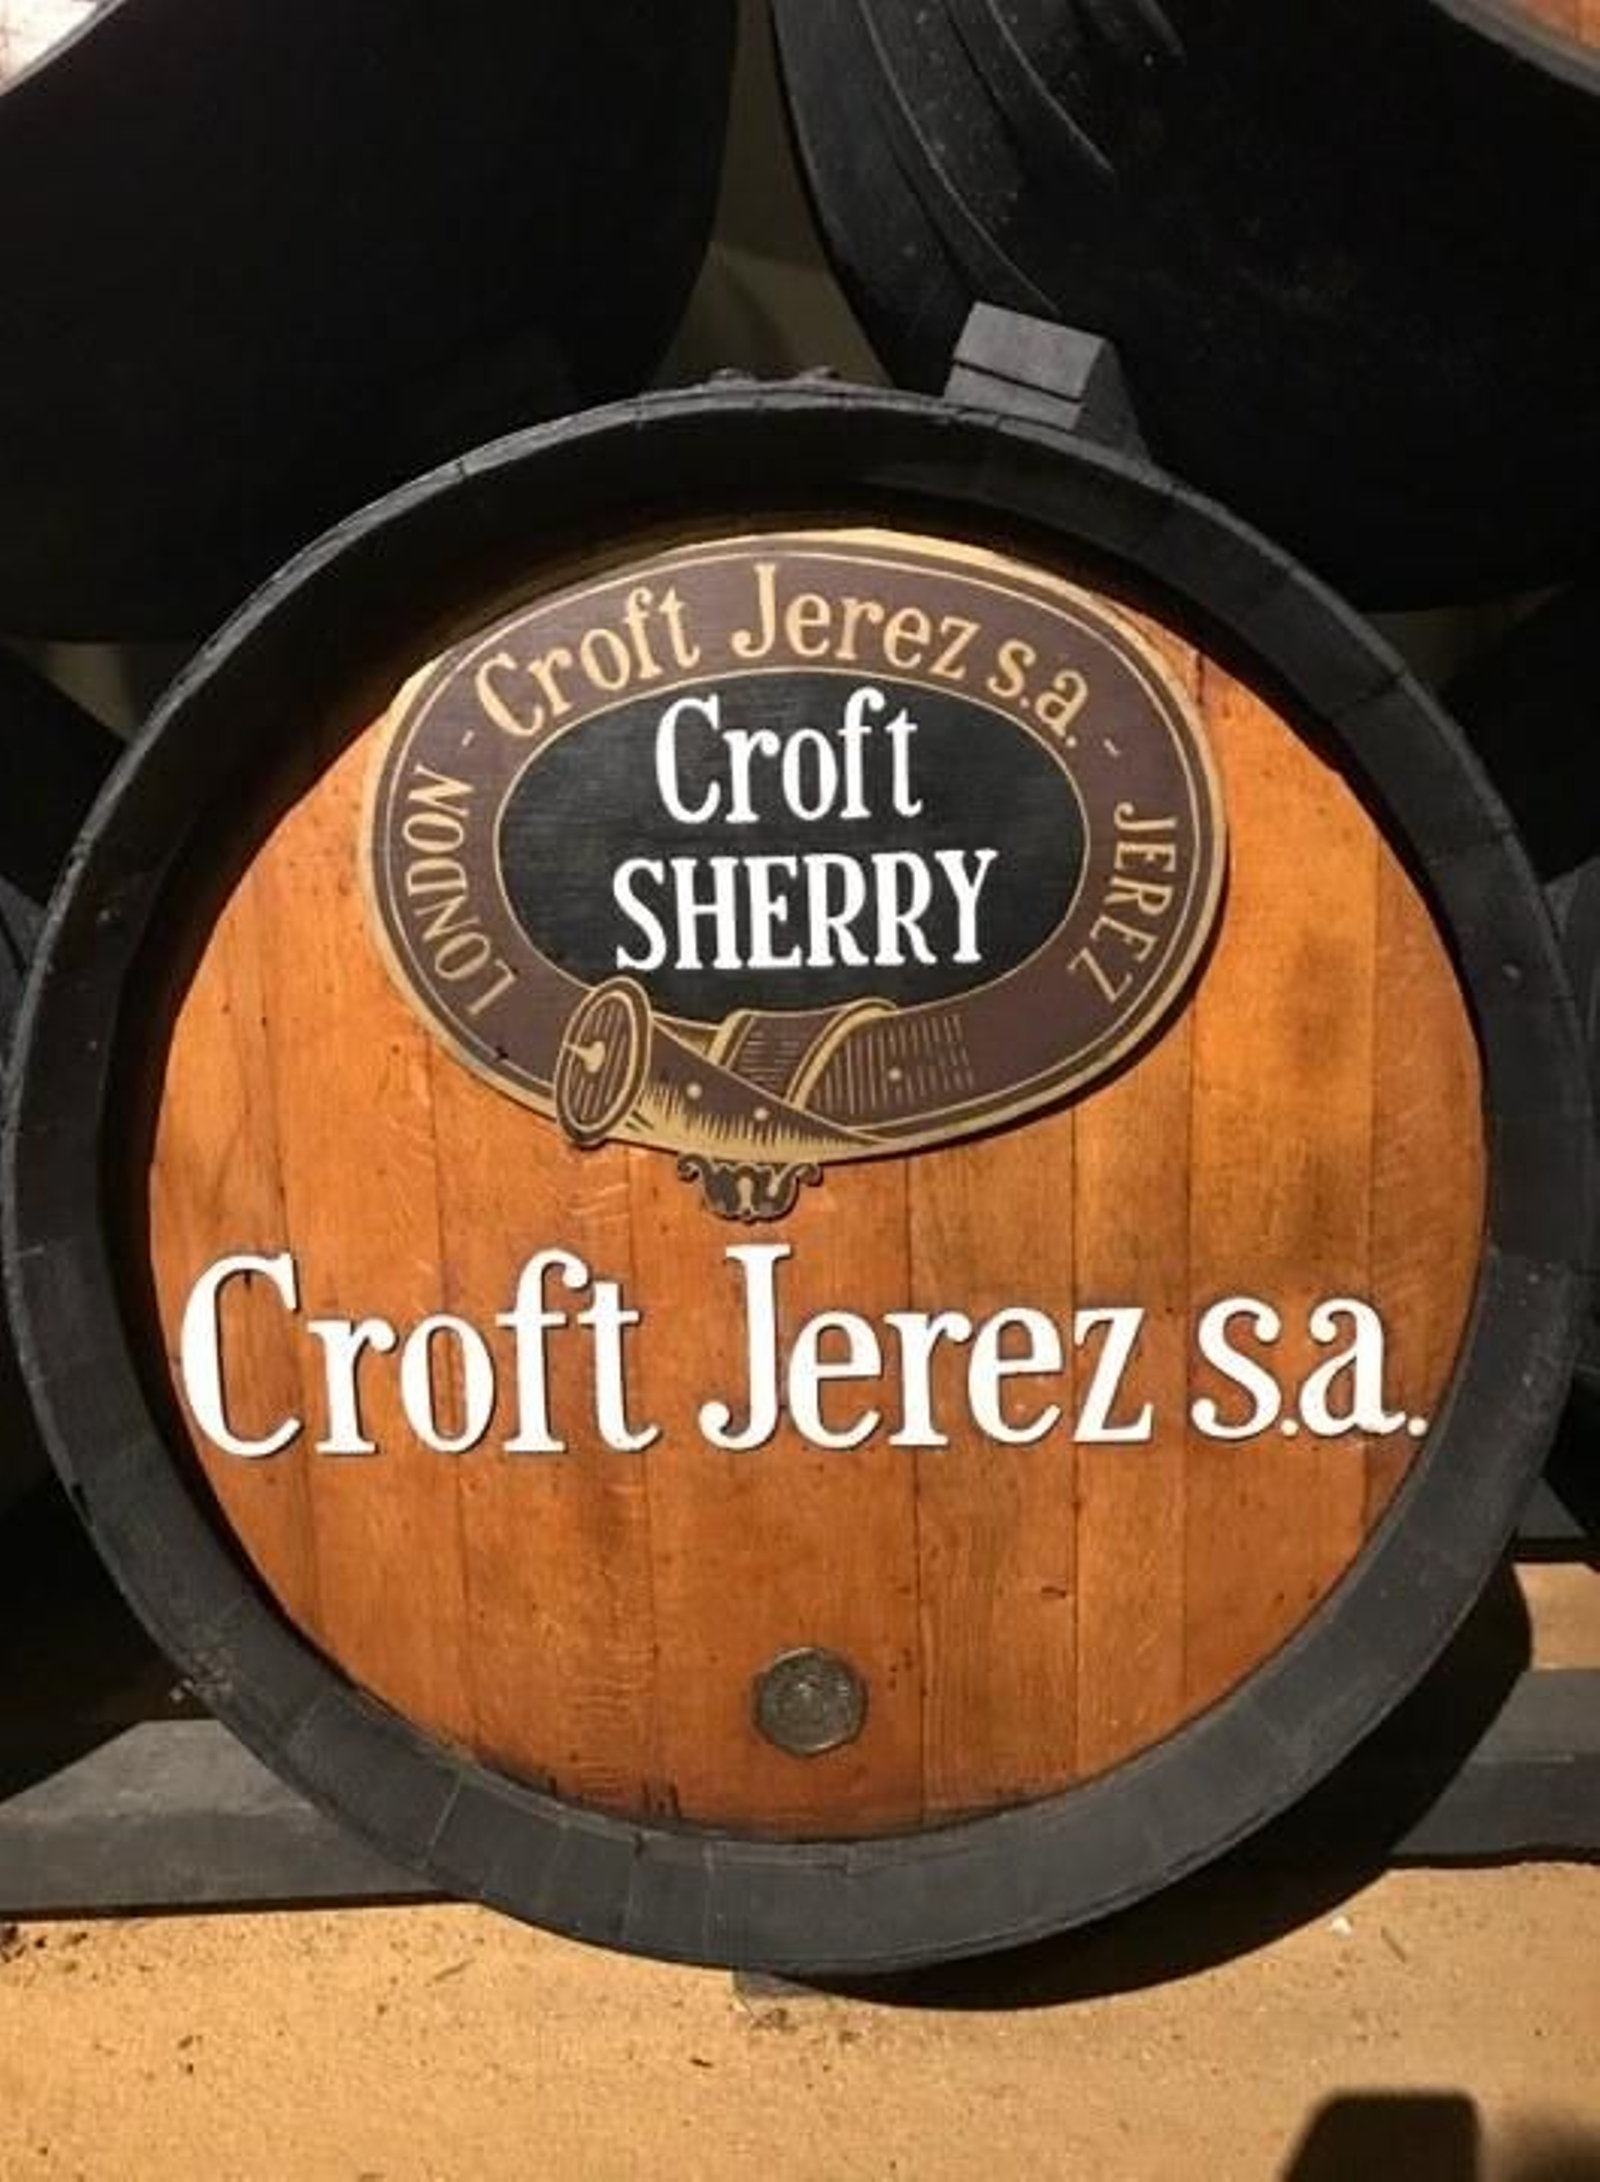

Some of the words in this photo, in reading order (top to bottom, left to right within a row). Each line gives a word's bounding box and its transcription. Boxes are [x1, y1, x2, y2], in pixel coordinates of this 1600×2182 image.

[403, 764, 518, 1016] LONDON
[473, 586, 700, 737] Croft
[732, 563, 981, 681] Jerez
[1066, 800, 1178, 1005] JEREZ
[655, 687, 922, 824] Croft
[612, 848, 998, 972] SHERRY
[181, 1247, 658, 1456] Croft
[699, 1243, 1153, 1452] Jerez
[1192, 1297, 1427, 1441] s.a.
